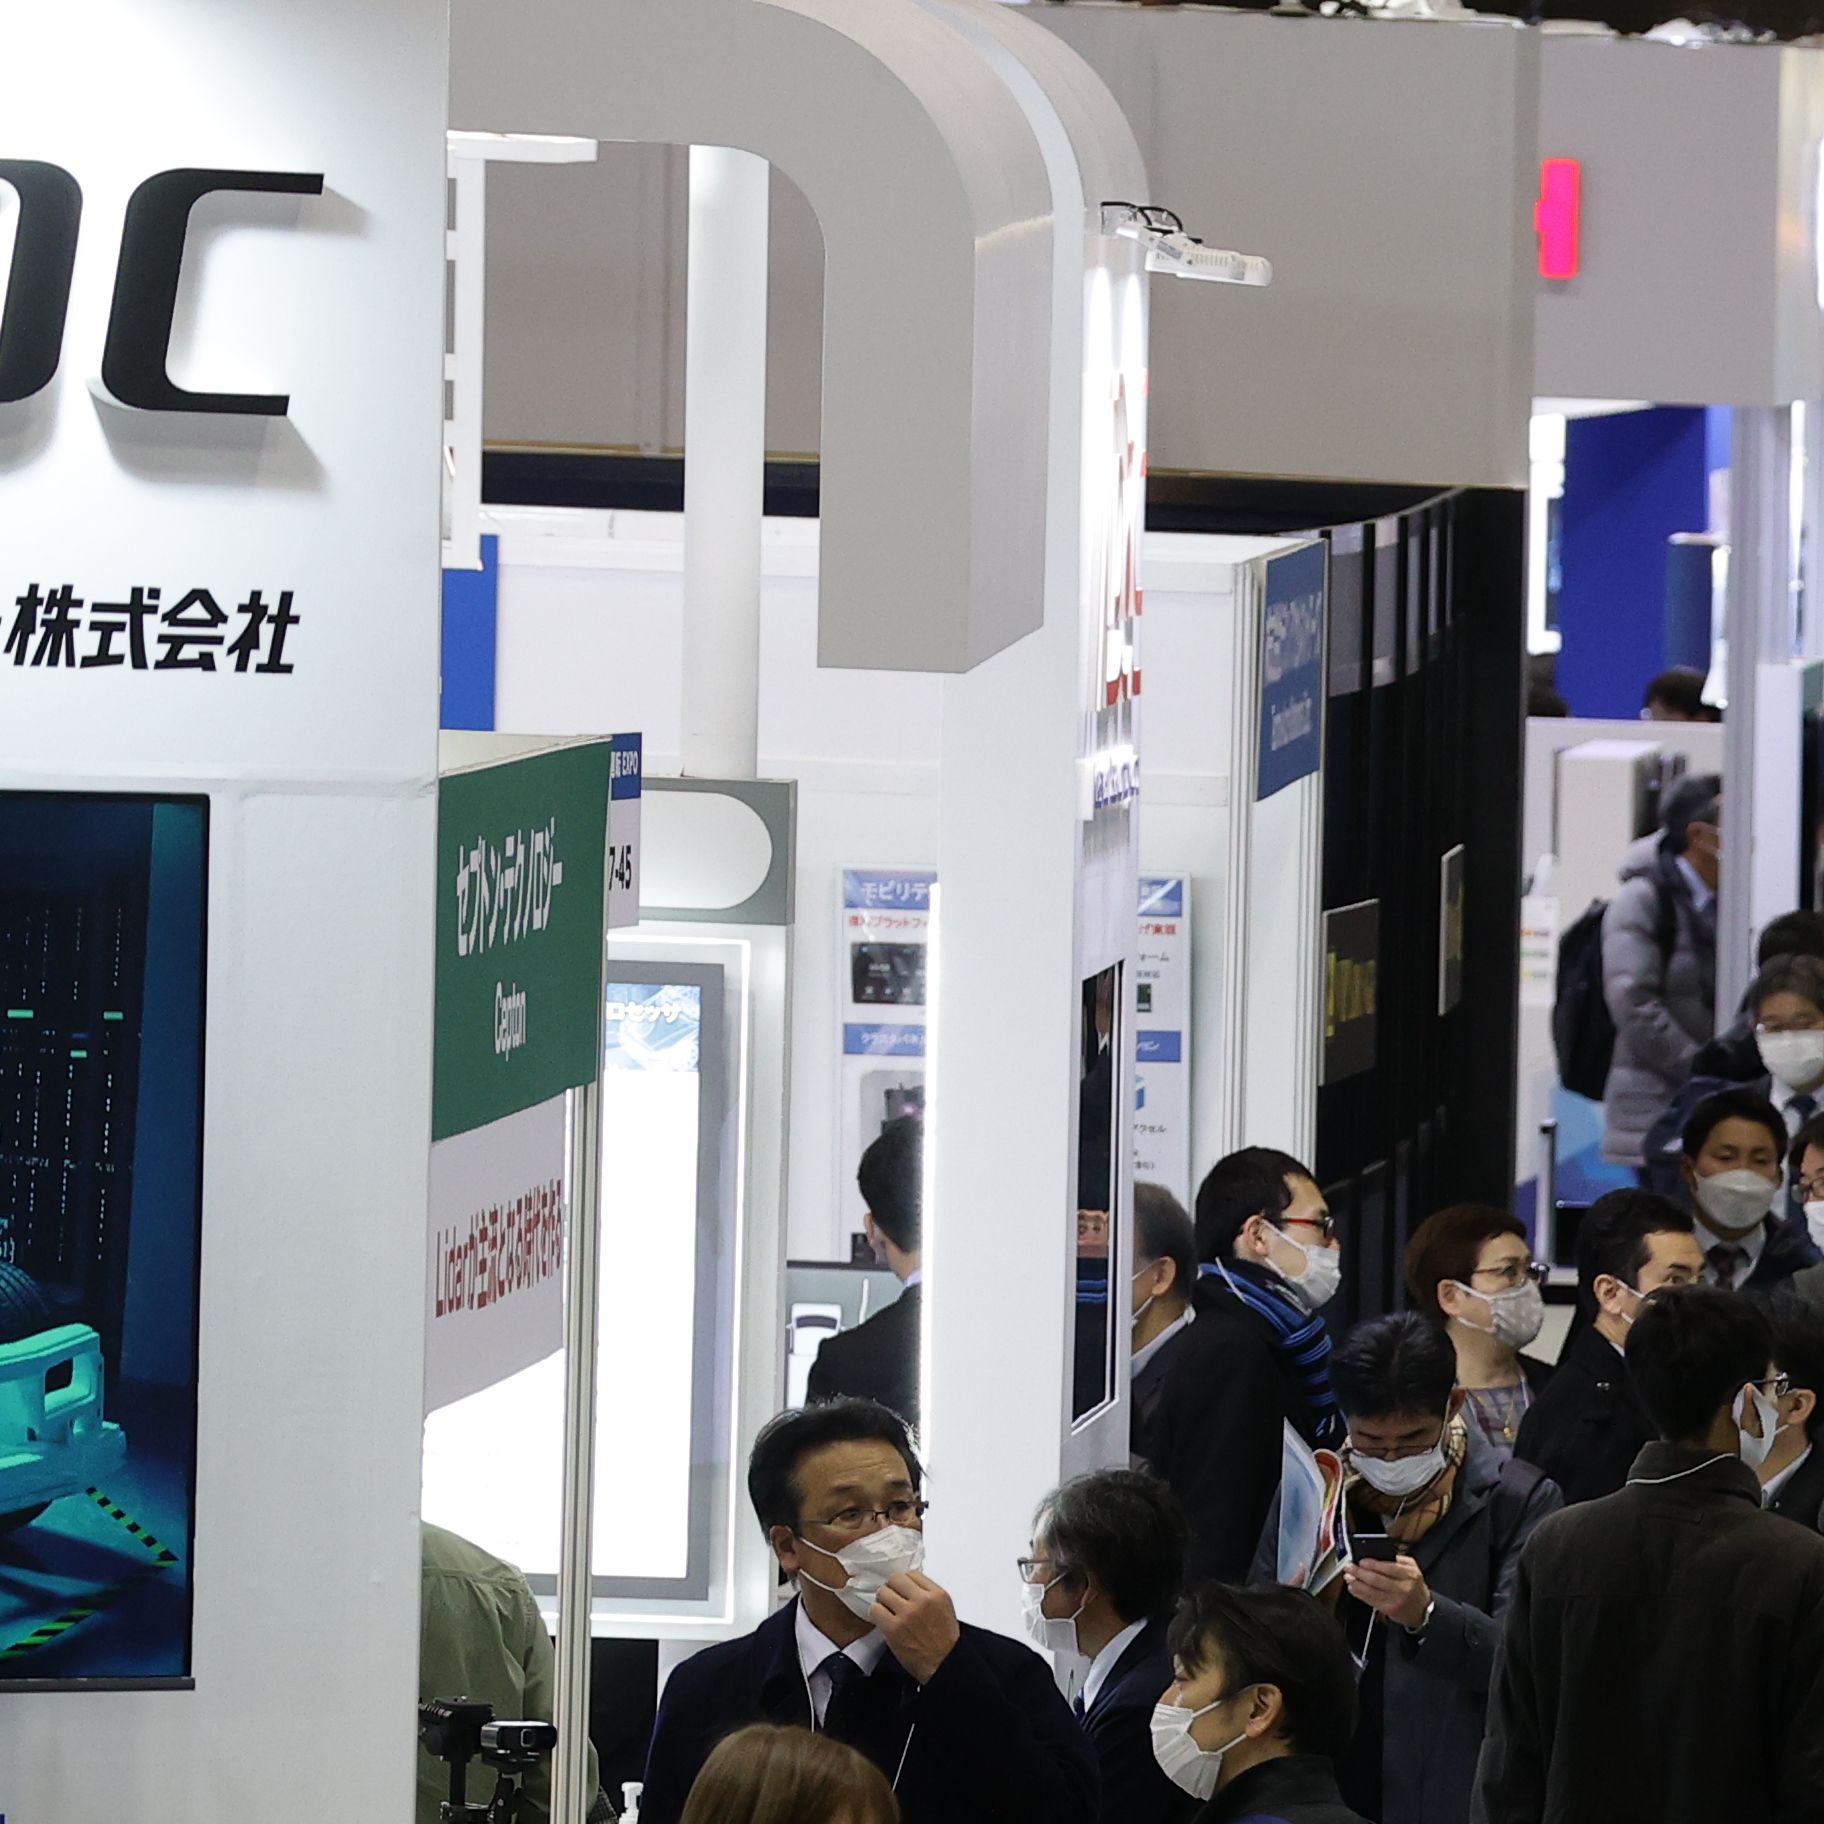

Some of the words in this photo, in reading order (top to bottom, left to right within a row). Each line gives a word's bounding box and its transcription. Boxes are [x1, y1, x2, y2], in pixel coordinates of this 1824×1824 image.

[0, 583, 300, 674] 株式会社
[494, 981, 527, 1062] Cepton
